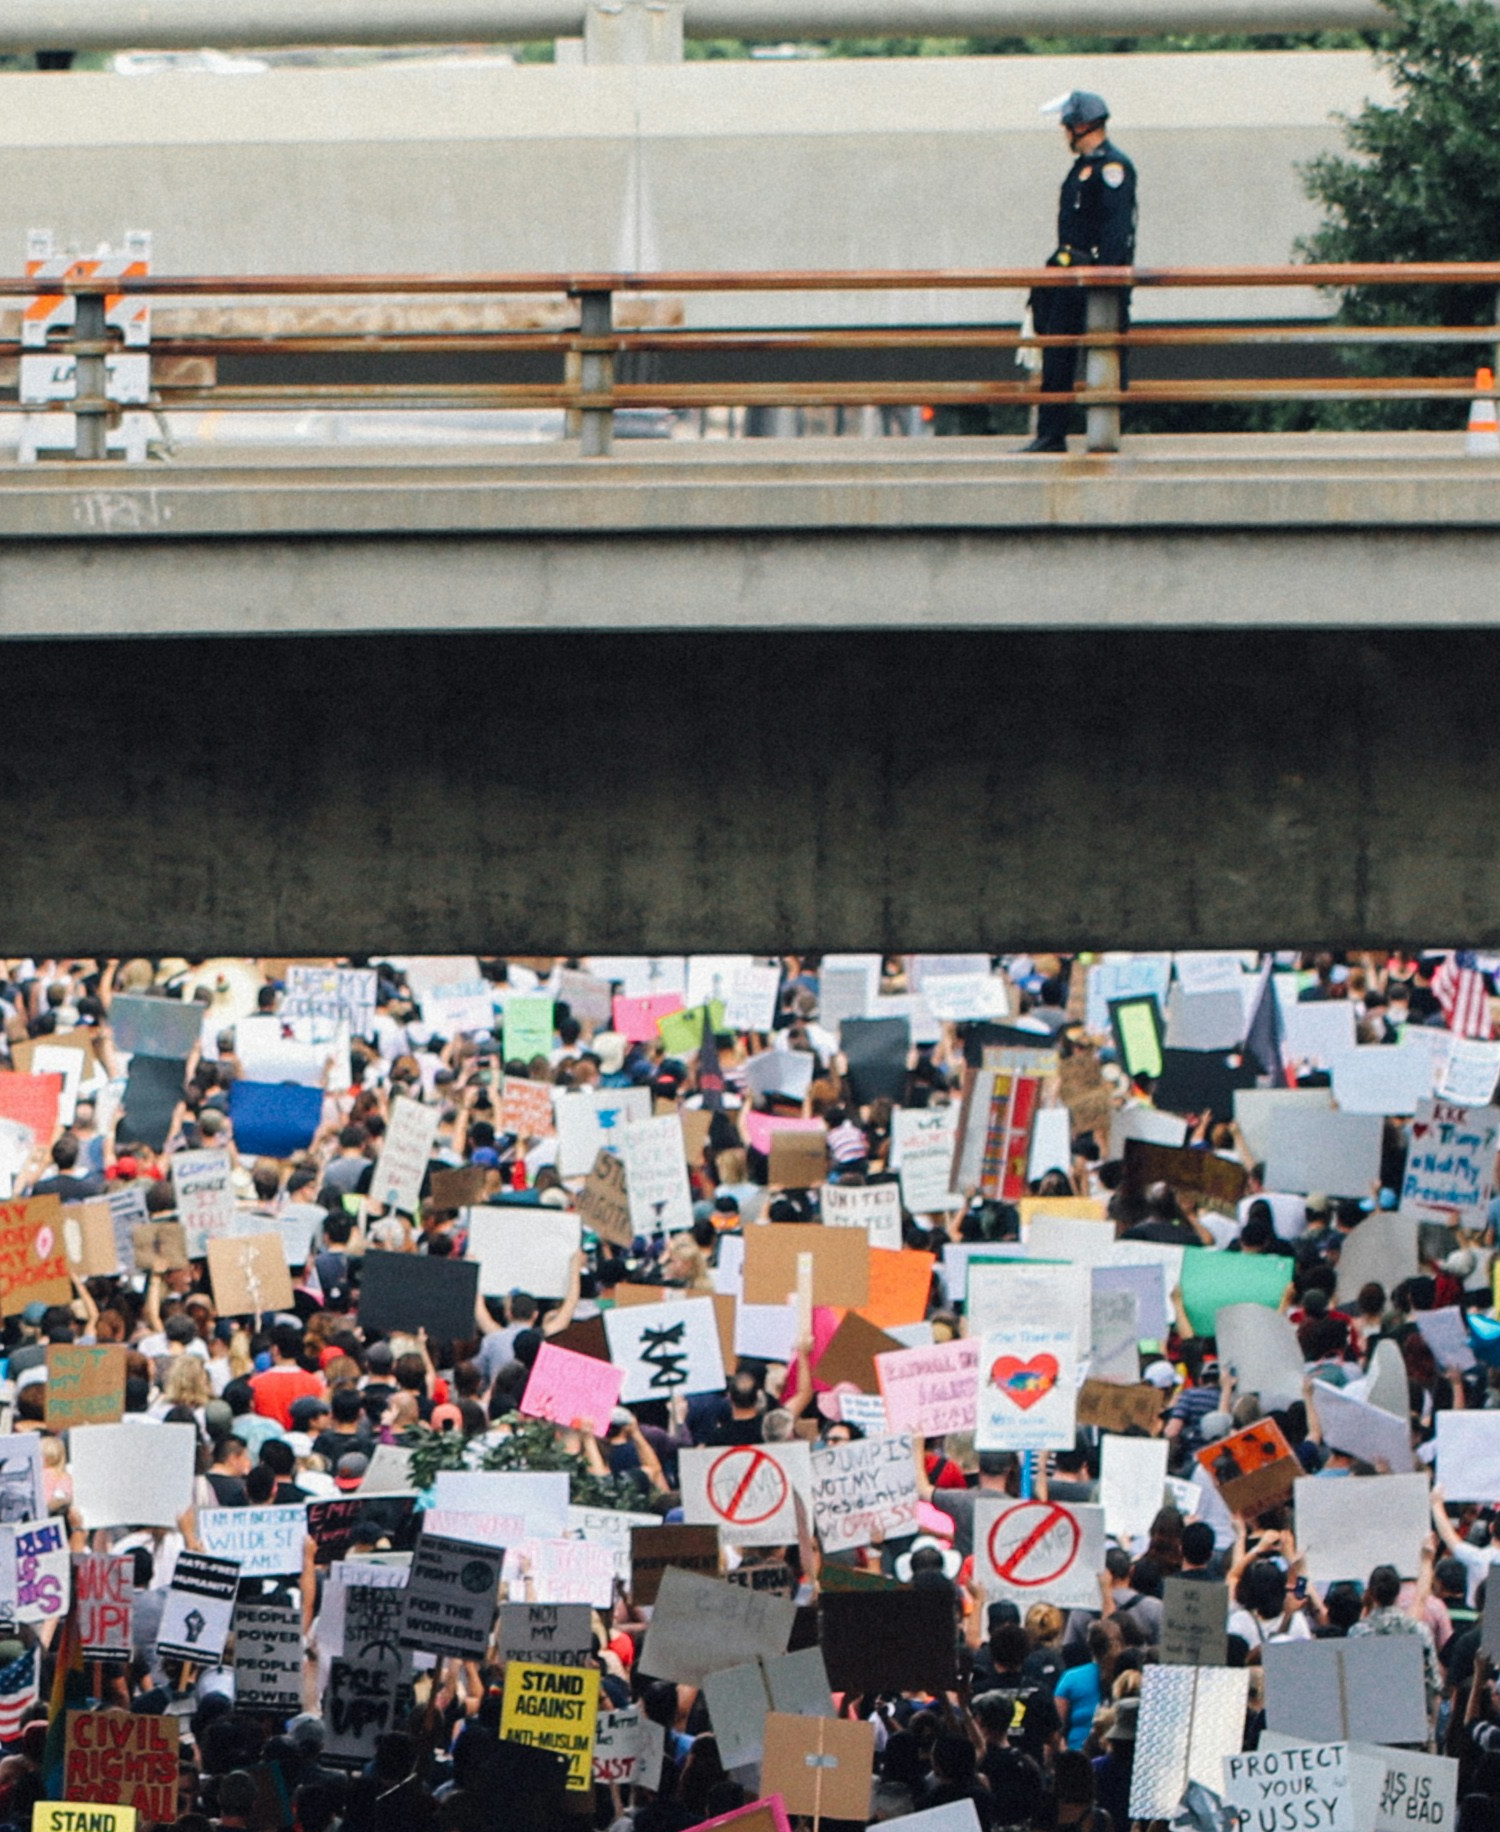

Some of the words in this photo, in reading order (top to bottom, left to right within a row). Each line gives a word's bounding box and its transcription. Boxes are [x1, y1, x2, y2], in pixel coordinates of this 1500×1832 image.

[237, 1610, 300, 1624] PEOPLE
[237, 1629, 300, 1643] POWER
[237, 1658, 300, 1672] PEOPLE
[260, 1673, 279, 1684] IN
[522, 1671, 584, 1695] STAND
[237, 1690, 300, 1704] POWER
[514, 1696, 586, 1720] AGAINST
[72, 1715, 170, 1751] CIVIL
[505, 1729, 589, 1751] ANTI-MUSLIM
[66, 1749, 178, 1785] RIGHTS
[1230, 1746, 1347, 1779] PROTECT
[1258, 1776, 1315, 1796] YOUR
